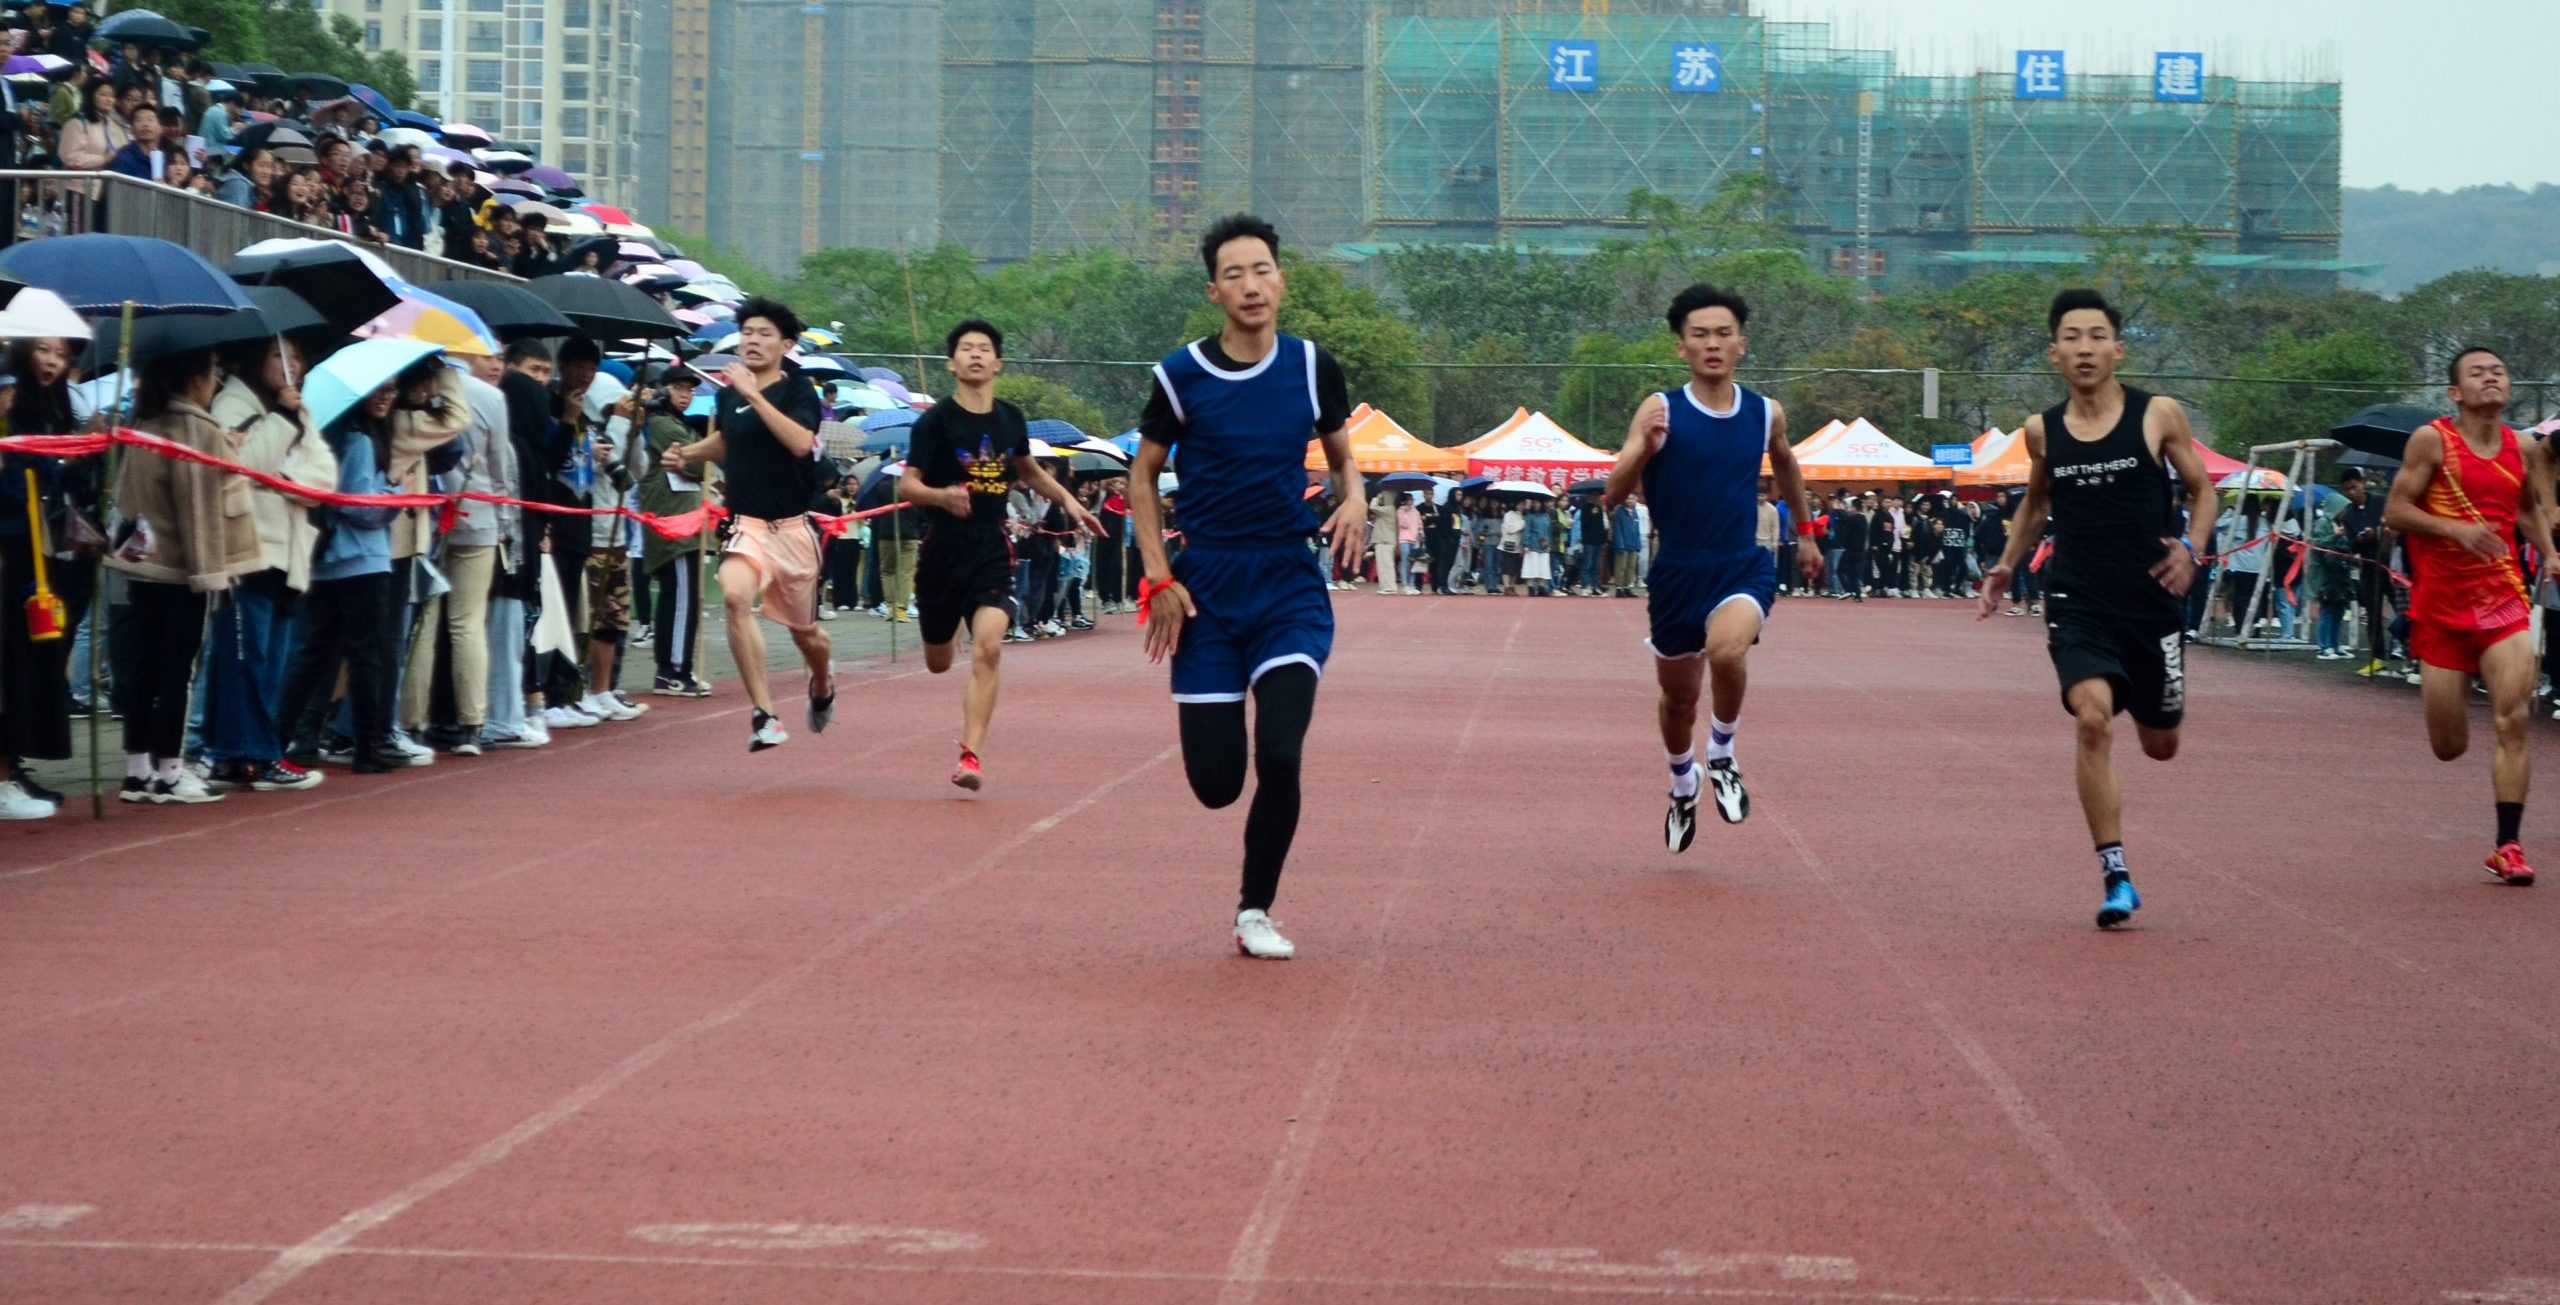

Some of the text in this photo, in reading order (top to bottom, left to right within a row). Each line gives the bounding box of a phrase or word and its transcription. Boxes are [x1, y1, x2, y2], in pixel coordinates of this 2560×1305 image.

[2053, 457, 2139, 478] BEAT THE HERO
